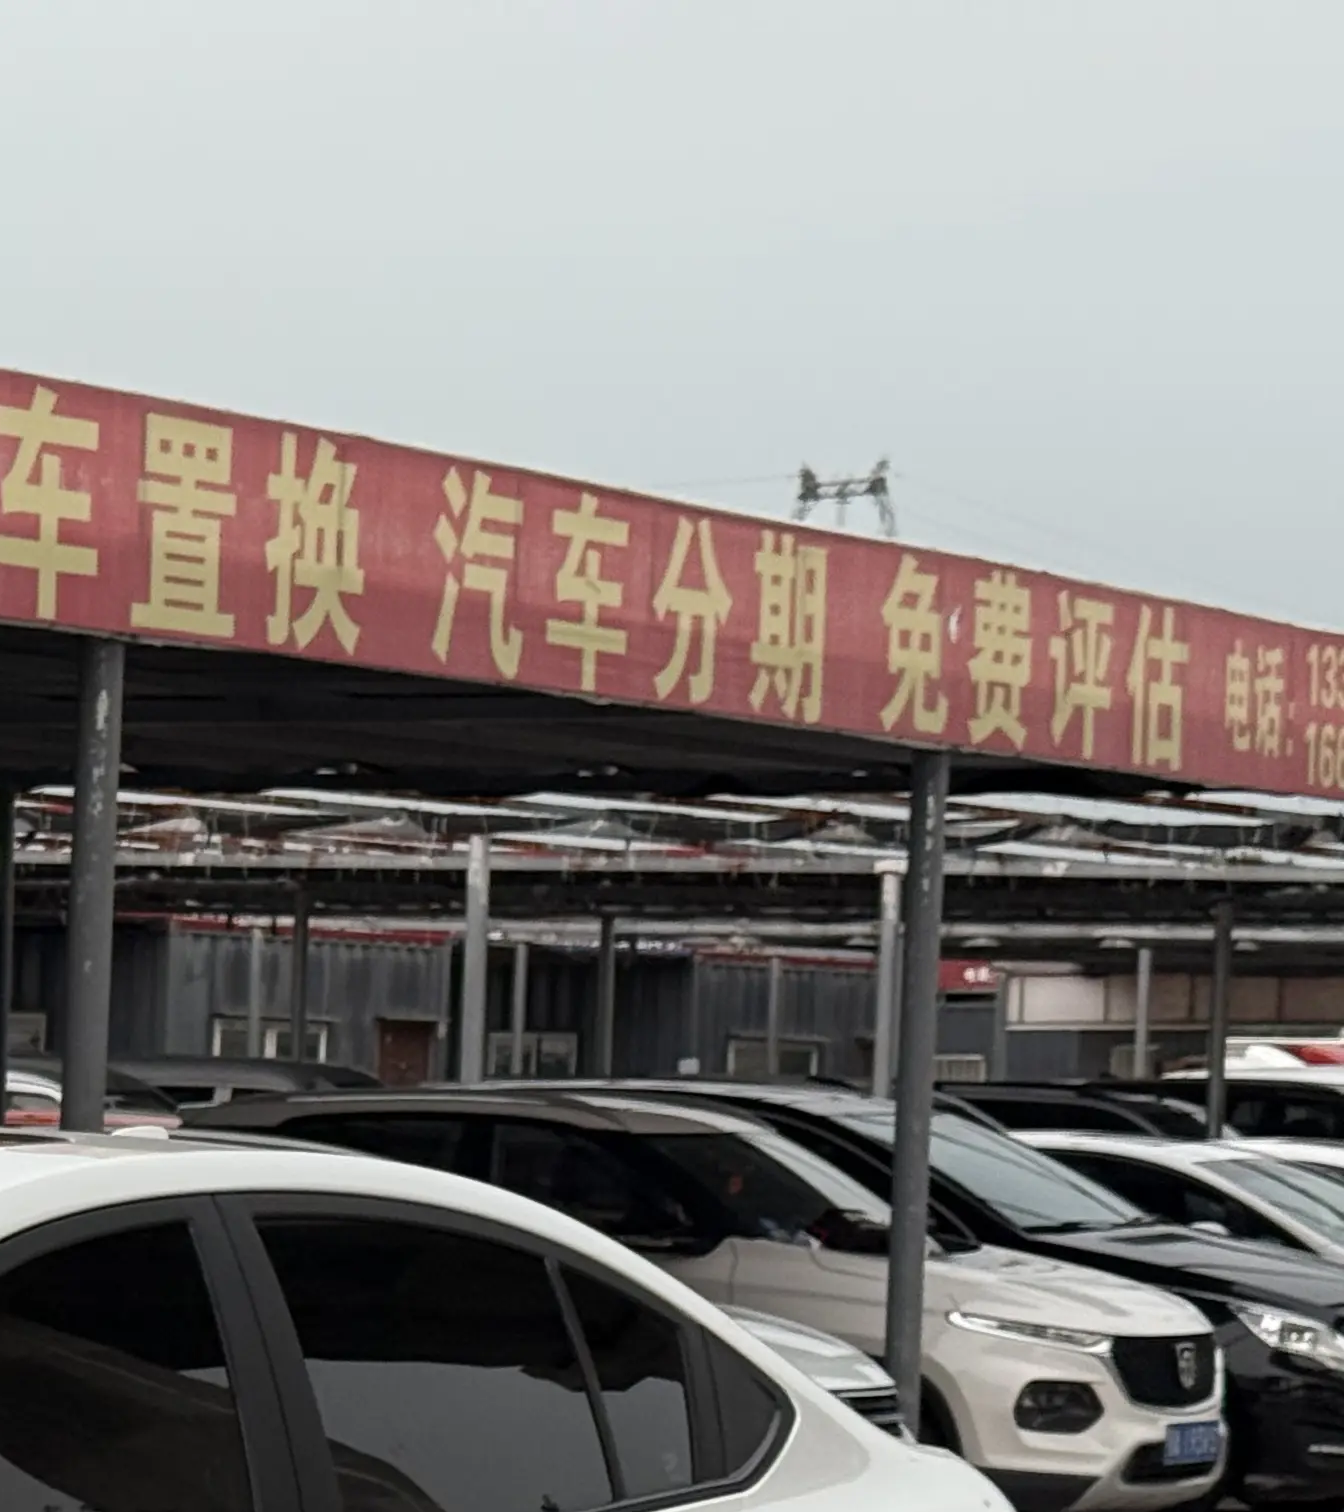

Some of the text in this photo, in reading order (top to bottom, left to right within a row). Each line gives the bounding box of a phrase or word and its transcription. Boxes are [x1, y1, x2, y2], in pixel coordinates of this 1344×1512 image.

[431, 466, 828, 724] 汽车分期
[880, 553, 1189, 771] 免费评估
